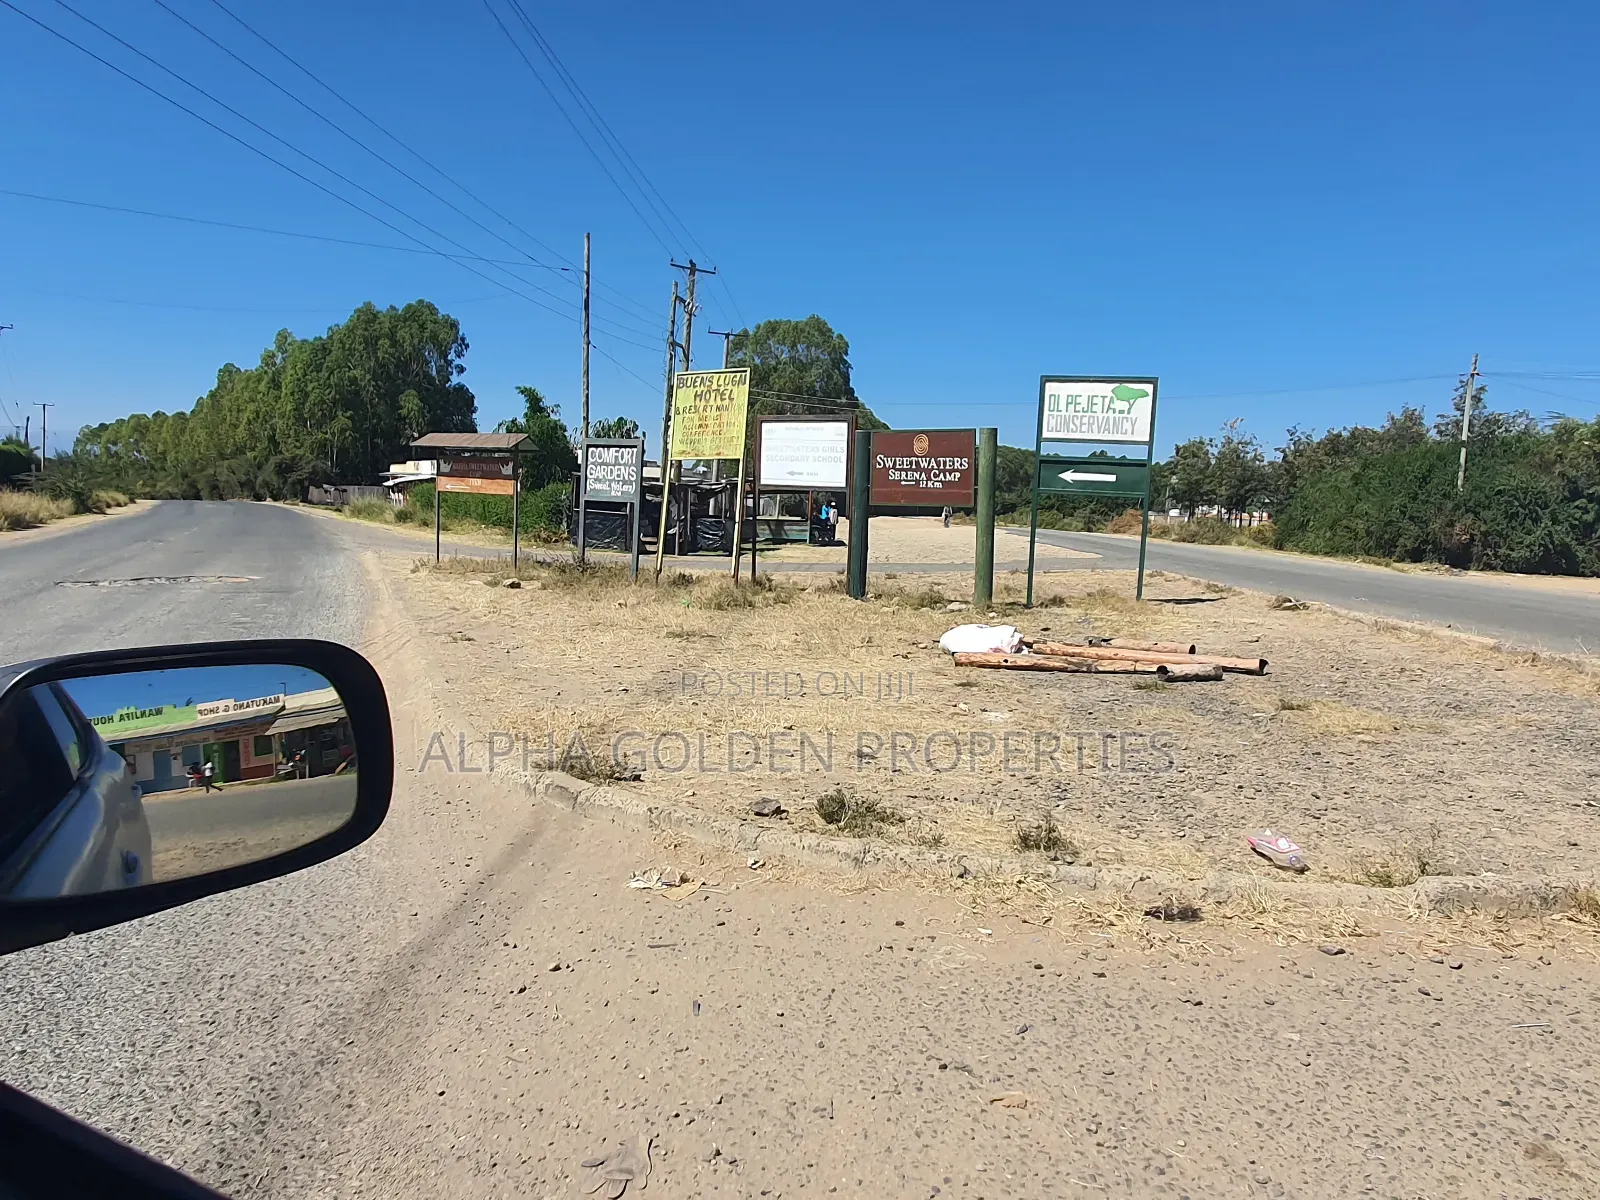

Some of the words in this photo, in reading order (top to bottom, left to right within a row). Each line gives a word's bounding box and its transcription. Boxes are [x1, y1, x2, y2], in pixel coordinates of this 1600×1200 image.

[677, 375, 714, 389] BUENS
[694, 388, 735, 403] HOTEL
[1047, 393, 1062, 412] OL
[1066, 394, 1116, 414] PEJETA
[1046, 414, 1138, 435] CONSERVANCY
[588, 447, 637, 464] COMFORT
[822, 445, 845, 453] GIRLS
[766, 454, 810, 463] SECONDARY
[812, 455, 843, 463] SCHOOL
[876, 454, 968, 469] SWEETWATERS
[587, 464, 637, 480] GARDENS
[889, 469, 927, 480] SERENA
[931, 470, 961, 481] CAMP
